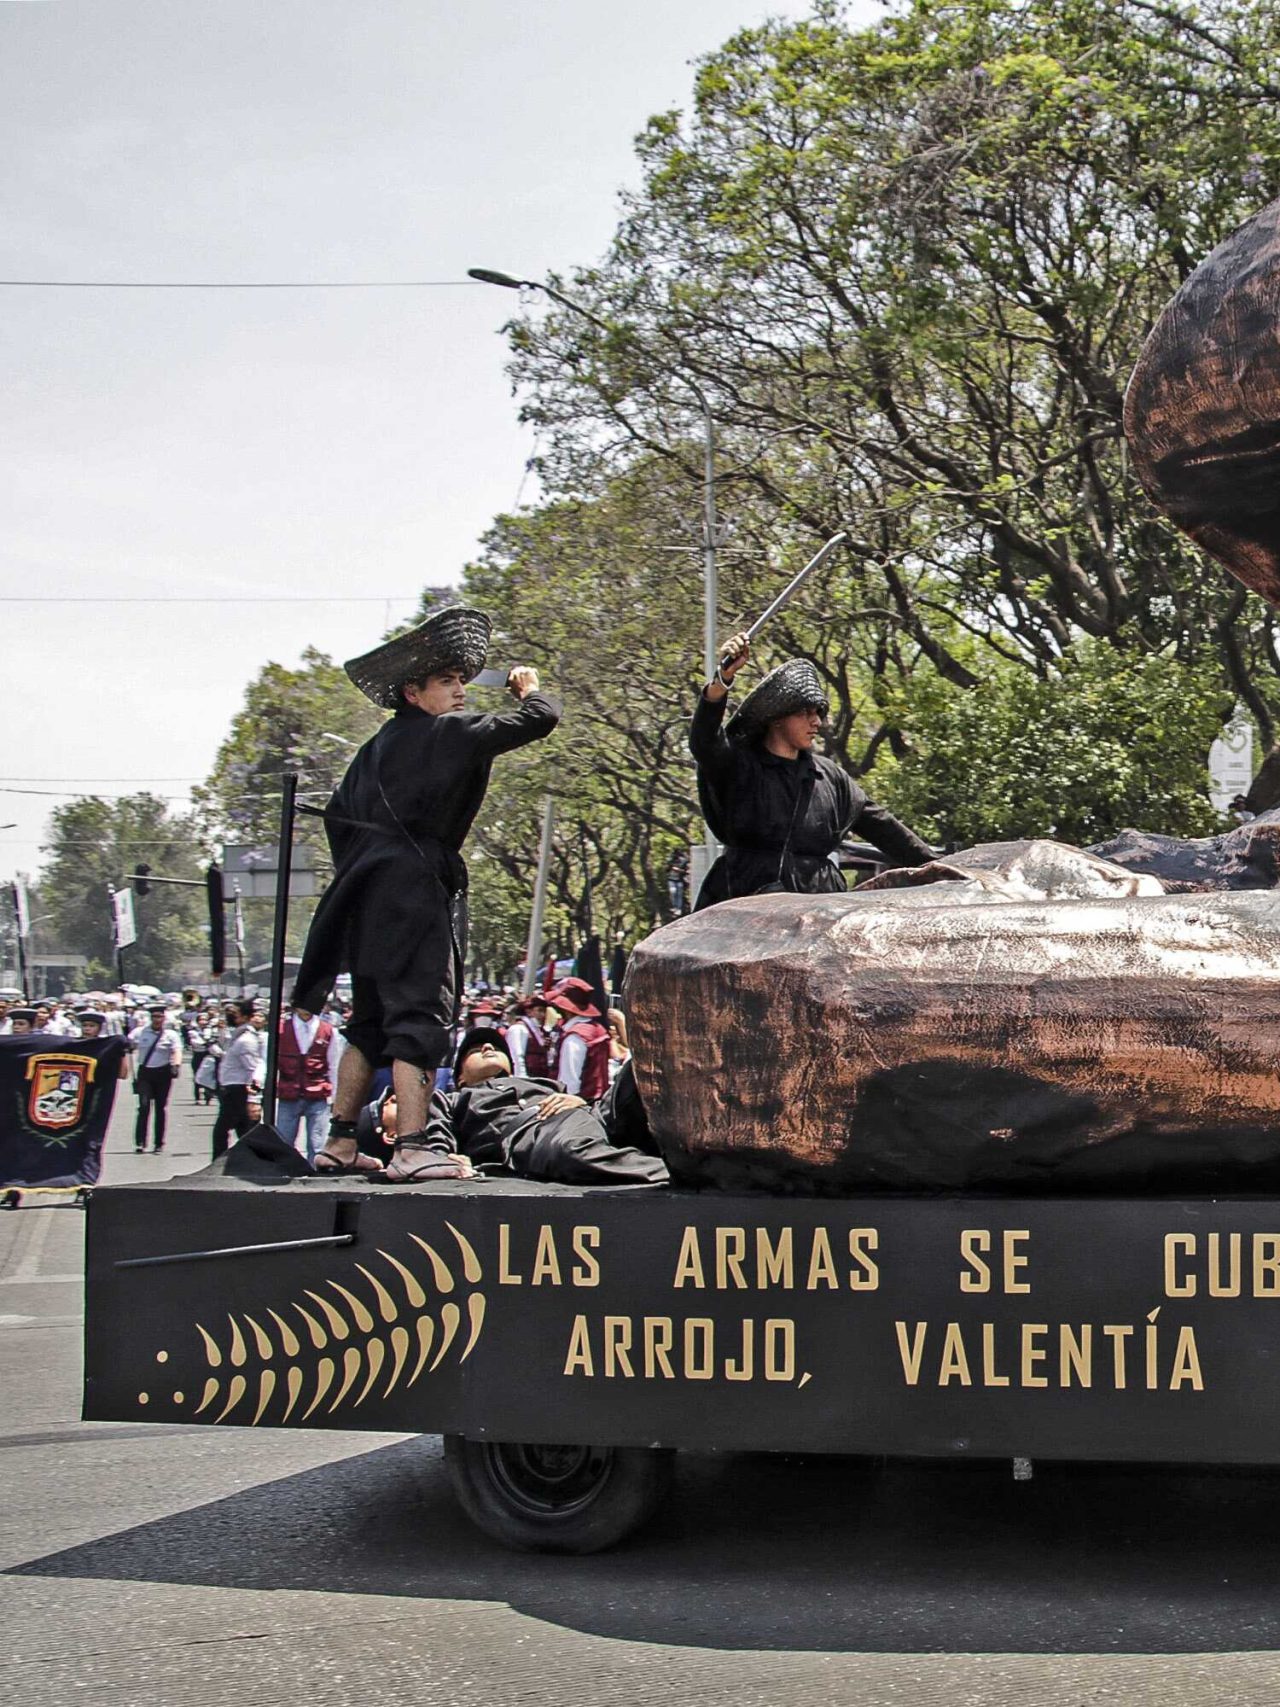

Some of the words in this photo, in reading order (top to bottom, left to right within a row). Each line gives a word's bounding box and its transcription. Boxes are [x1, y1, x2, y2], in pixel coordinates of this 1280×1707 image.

[498, 1223, 601, 1288] LAS
[673, 1225, 880, 1292] ARMAS
[959, 1229, 1032, 1295] SE
[563, 1314, 814, 1388] ARROJO,
[894, 1306, 1206, 1392] VALENTÍA
